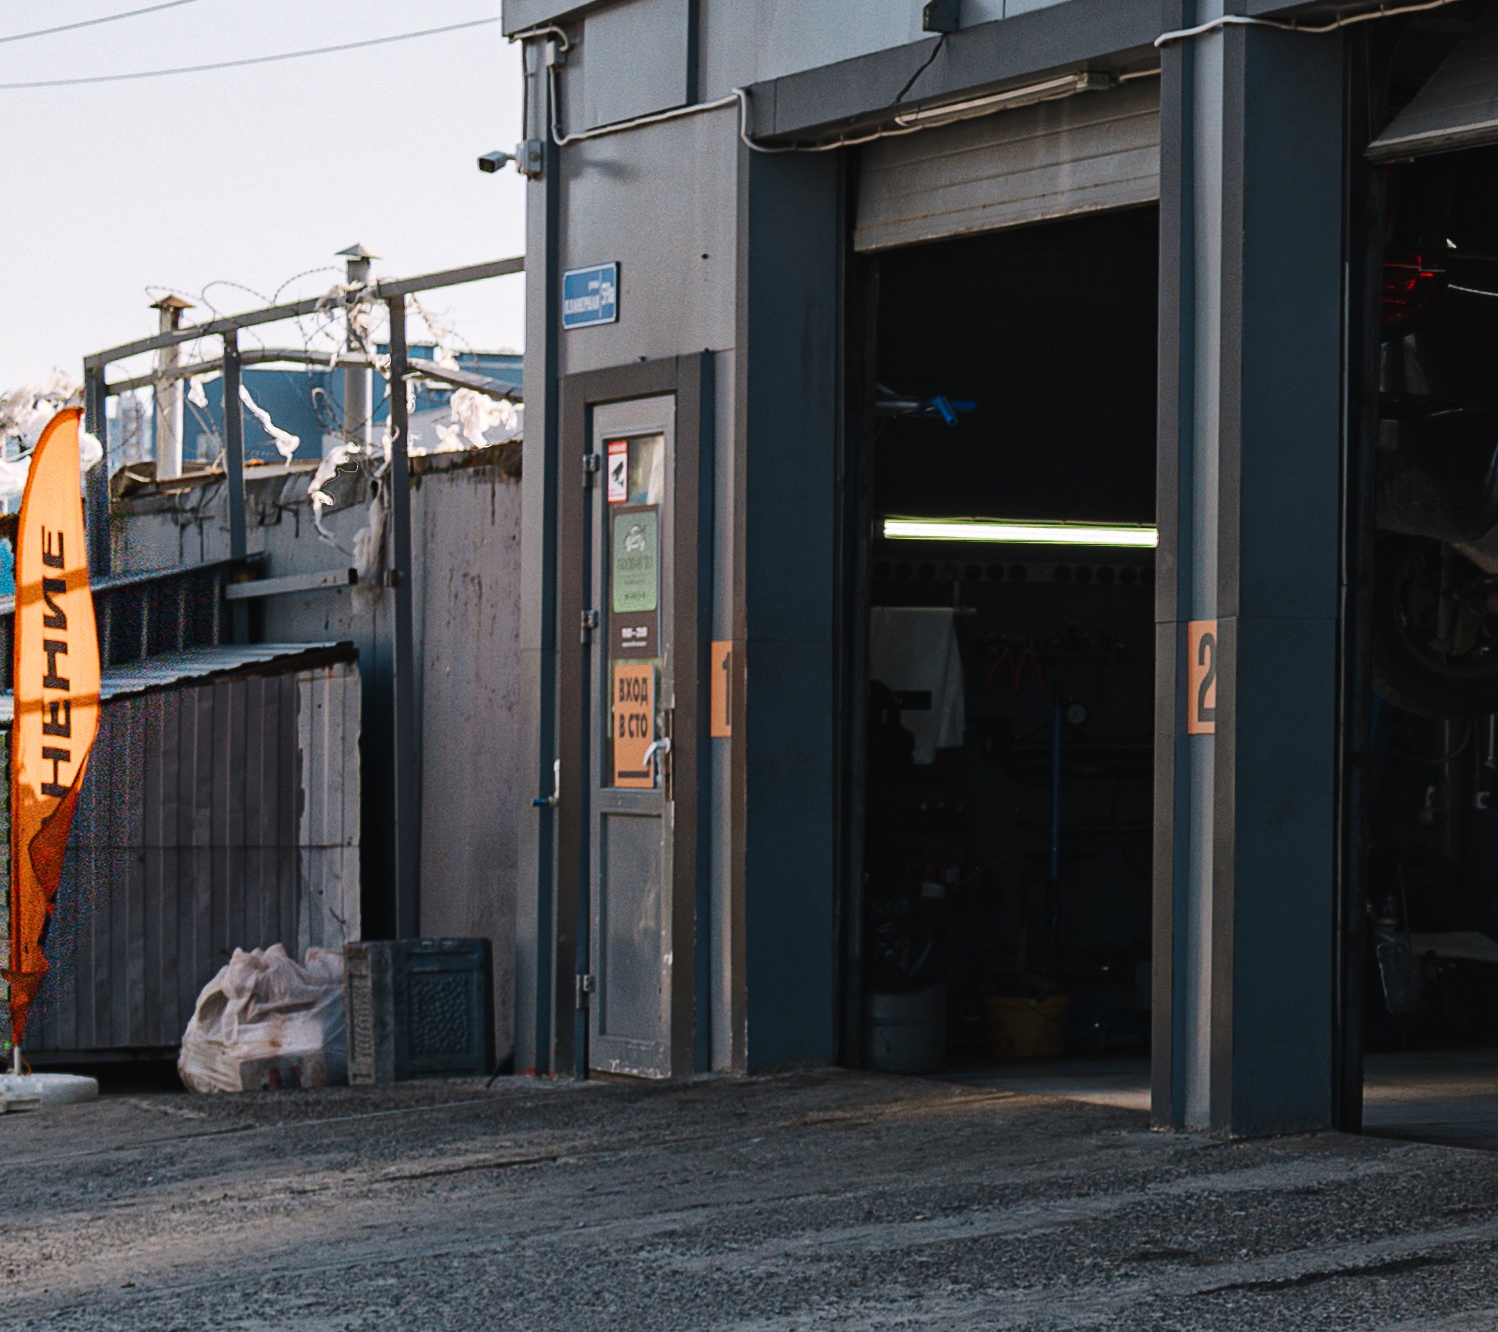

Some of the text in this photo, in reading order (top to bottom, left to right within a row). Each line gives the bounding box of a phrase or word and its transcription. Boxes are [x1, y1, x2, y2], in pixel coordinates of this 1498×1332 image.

[619, 677, 649, 707] ВХОД
[1198, 632, 1217, 723] 2
[619, 713, 649, 739] В СТО
